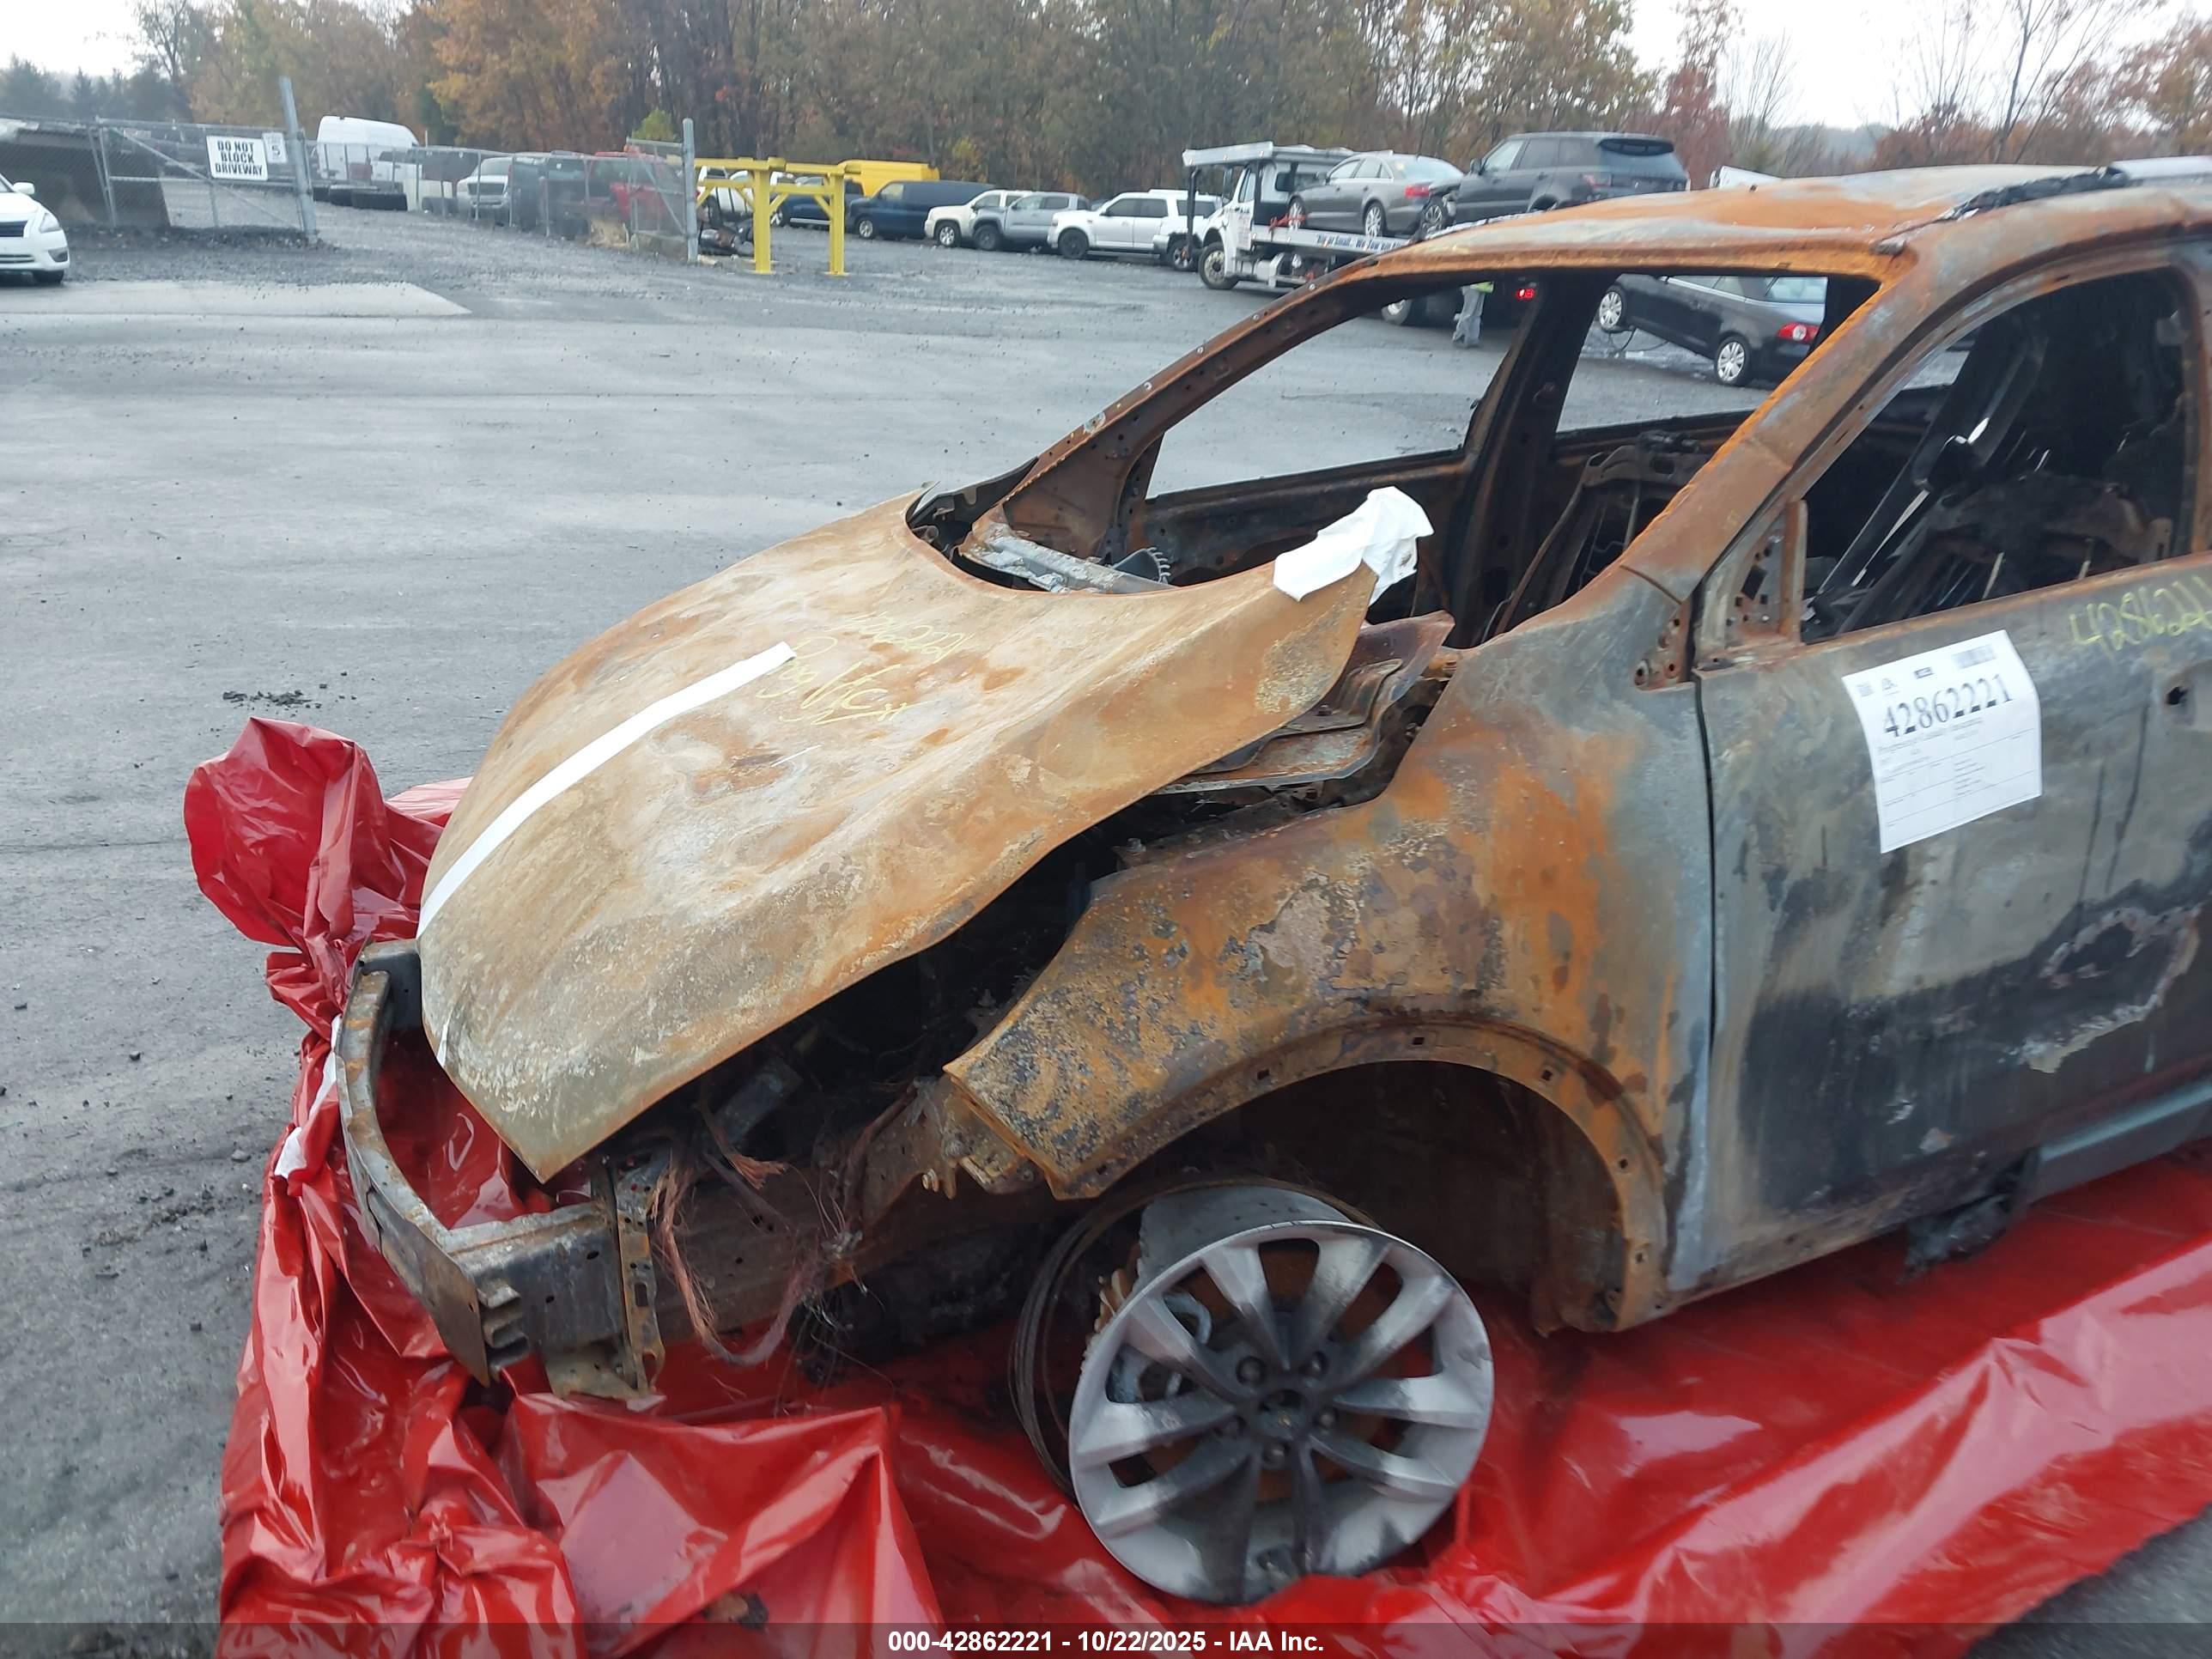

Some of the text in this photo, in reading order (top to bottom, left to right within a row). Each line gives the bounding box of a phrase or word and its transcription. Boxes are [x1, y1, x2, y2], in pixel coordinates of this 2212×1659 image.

[217, 141, 254, 152] DO NOT
[271, 145, 280, 155] 5
[221, 151, 254, 163] BLOCK
[216, 163, 263, 176] DRIVEWAY
[1884, 674, 2013, 738] 42862221
